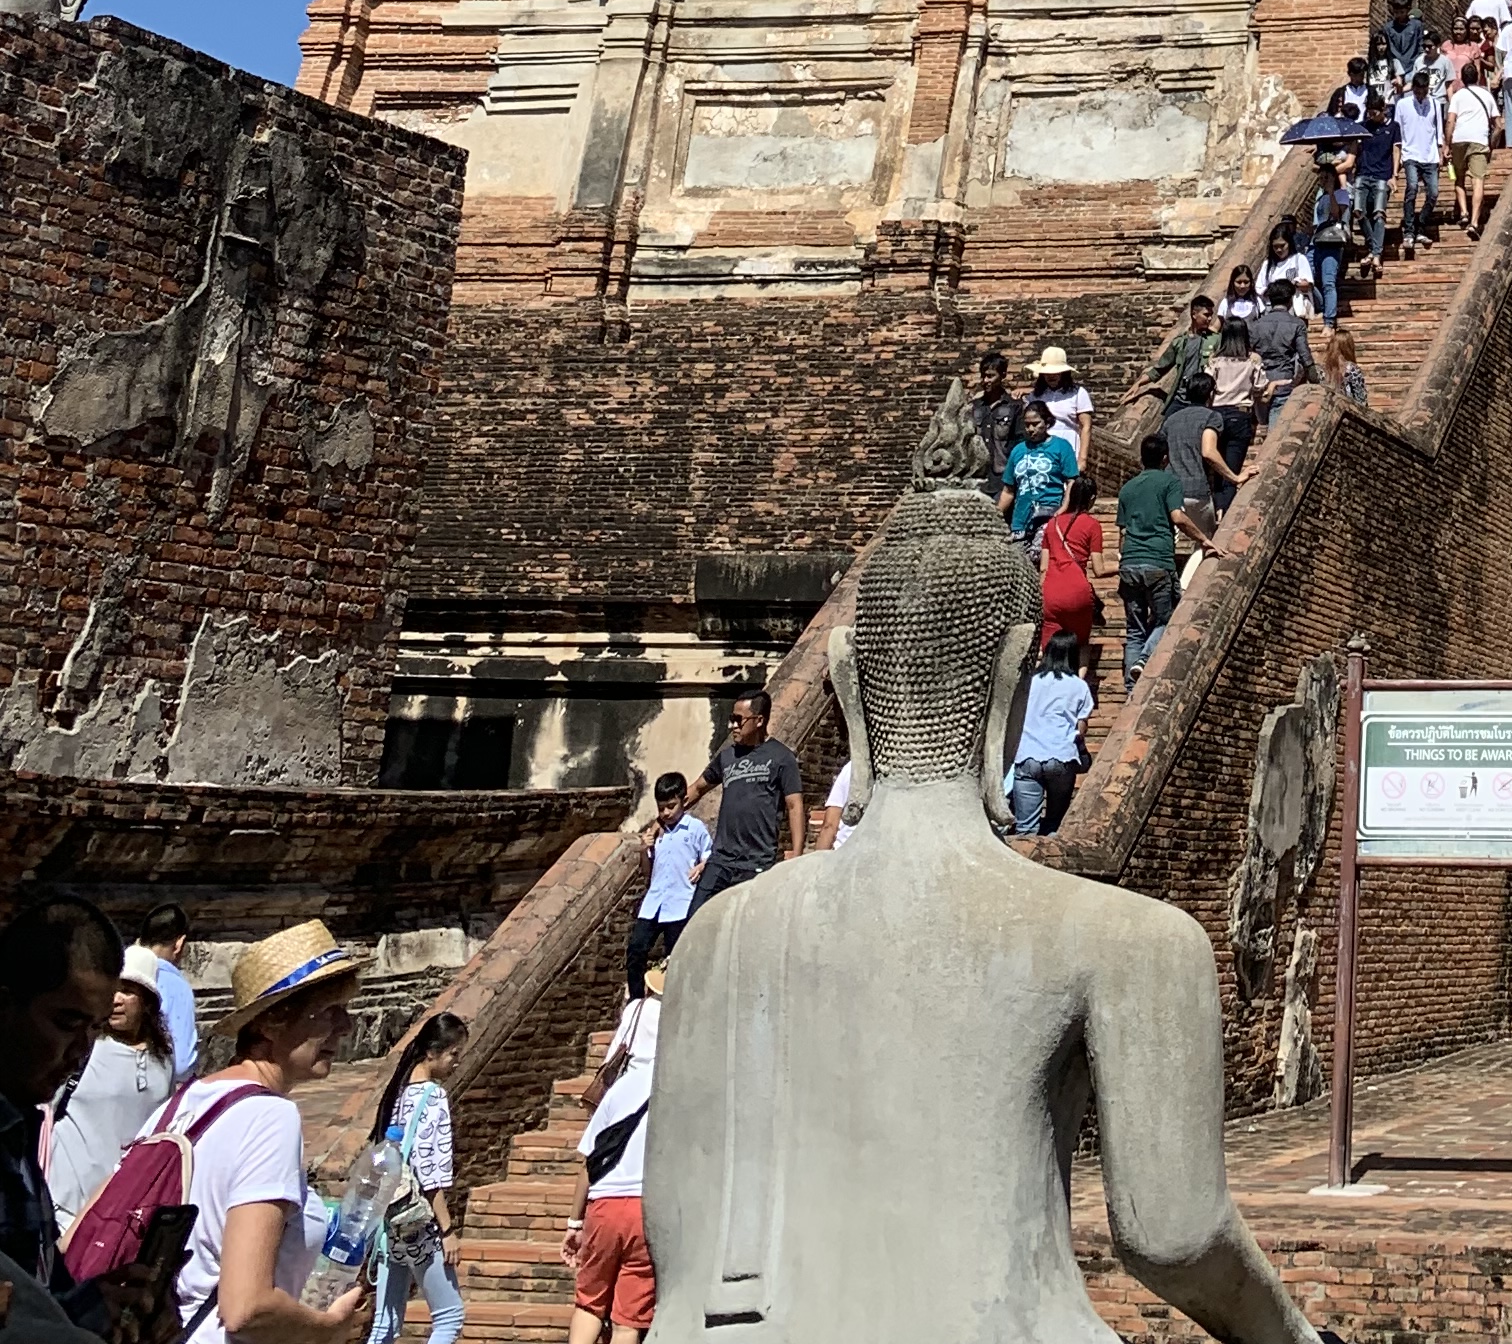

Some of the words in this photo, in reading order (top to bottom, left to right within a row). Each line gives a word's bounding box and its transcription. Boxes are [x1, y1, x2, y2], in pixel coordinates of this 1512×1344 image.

[1404, 748, 1445, 761] THINGS
[1447, 748, 1463, 761] TO
[1464, 749, 1478, 761] BE
[738, 759, 772, 773] Street
